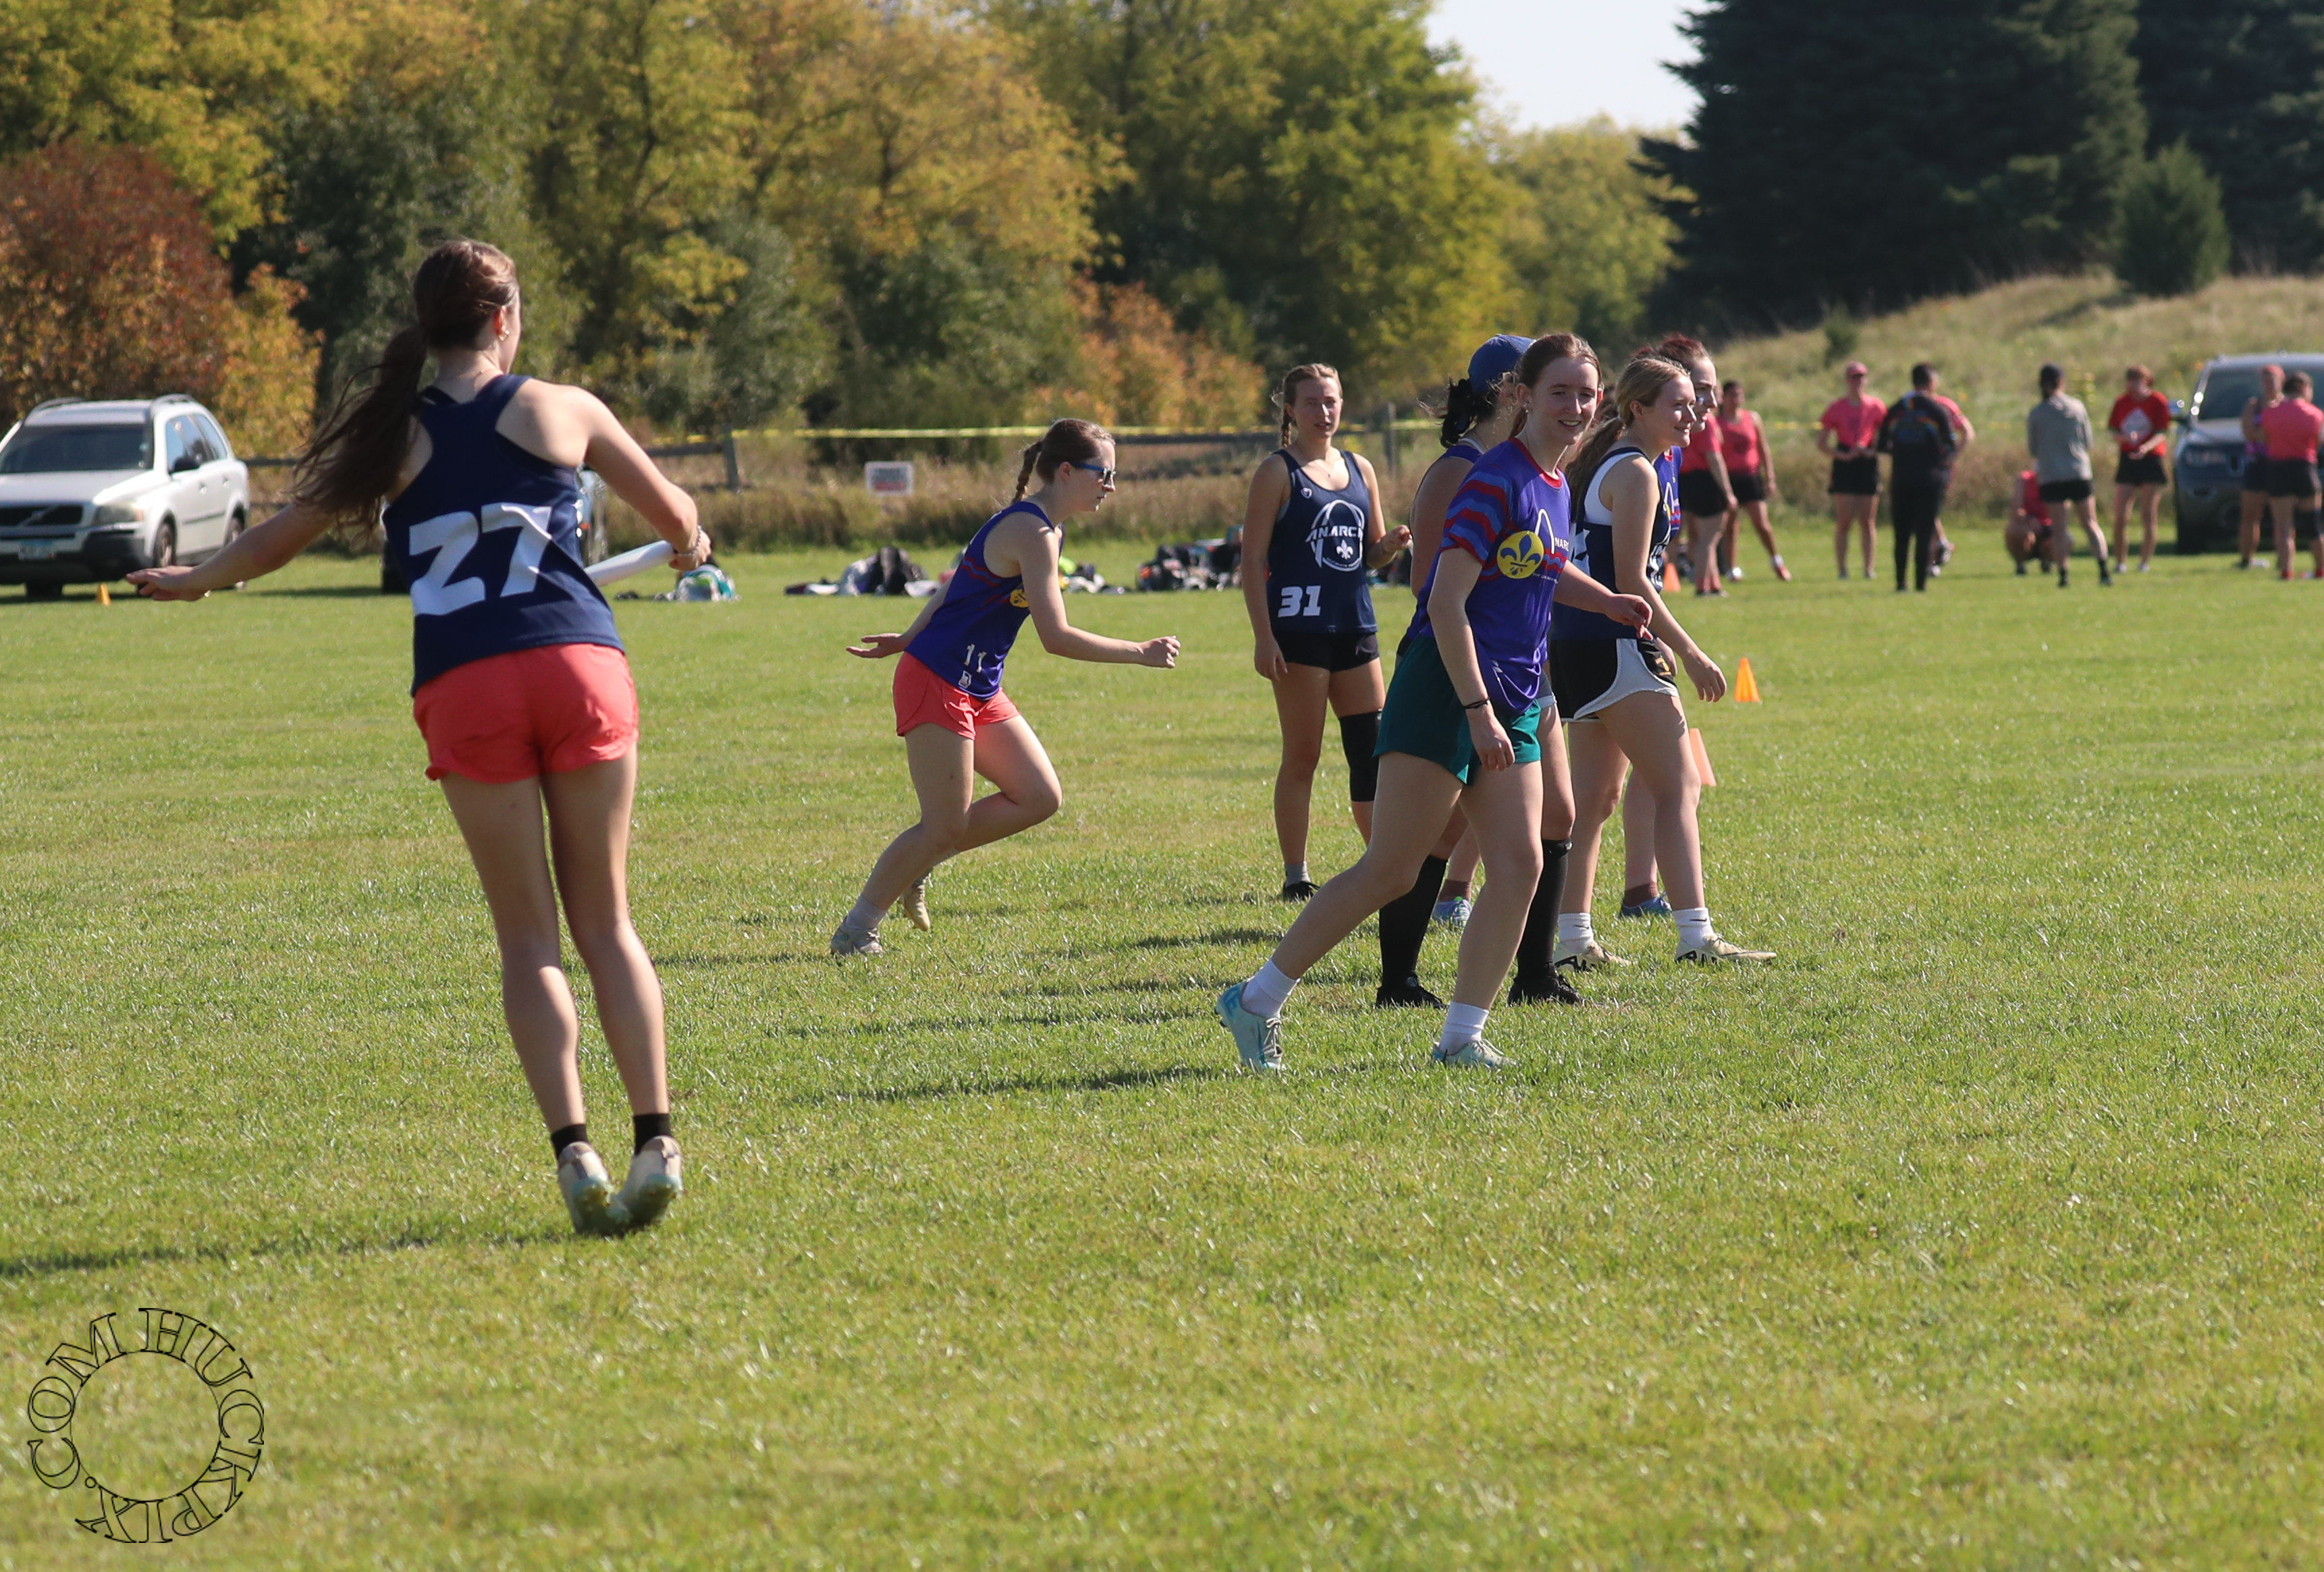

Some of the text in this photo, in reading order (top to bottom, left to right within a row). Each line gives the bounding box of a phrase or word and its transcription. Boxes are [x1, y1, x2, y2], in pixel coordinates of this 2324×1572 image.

[409, 502, 552, 616] 27
[1278, 585, 1322, 618] 31
[964, 643, 987, 673] 11
